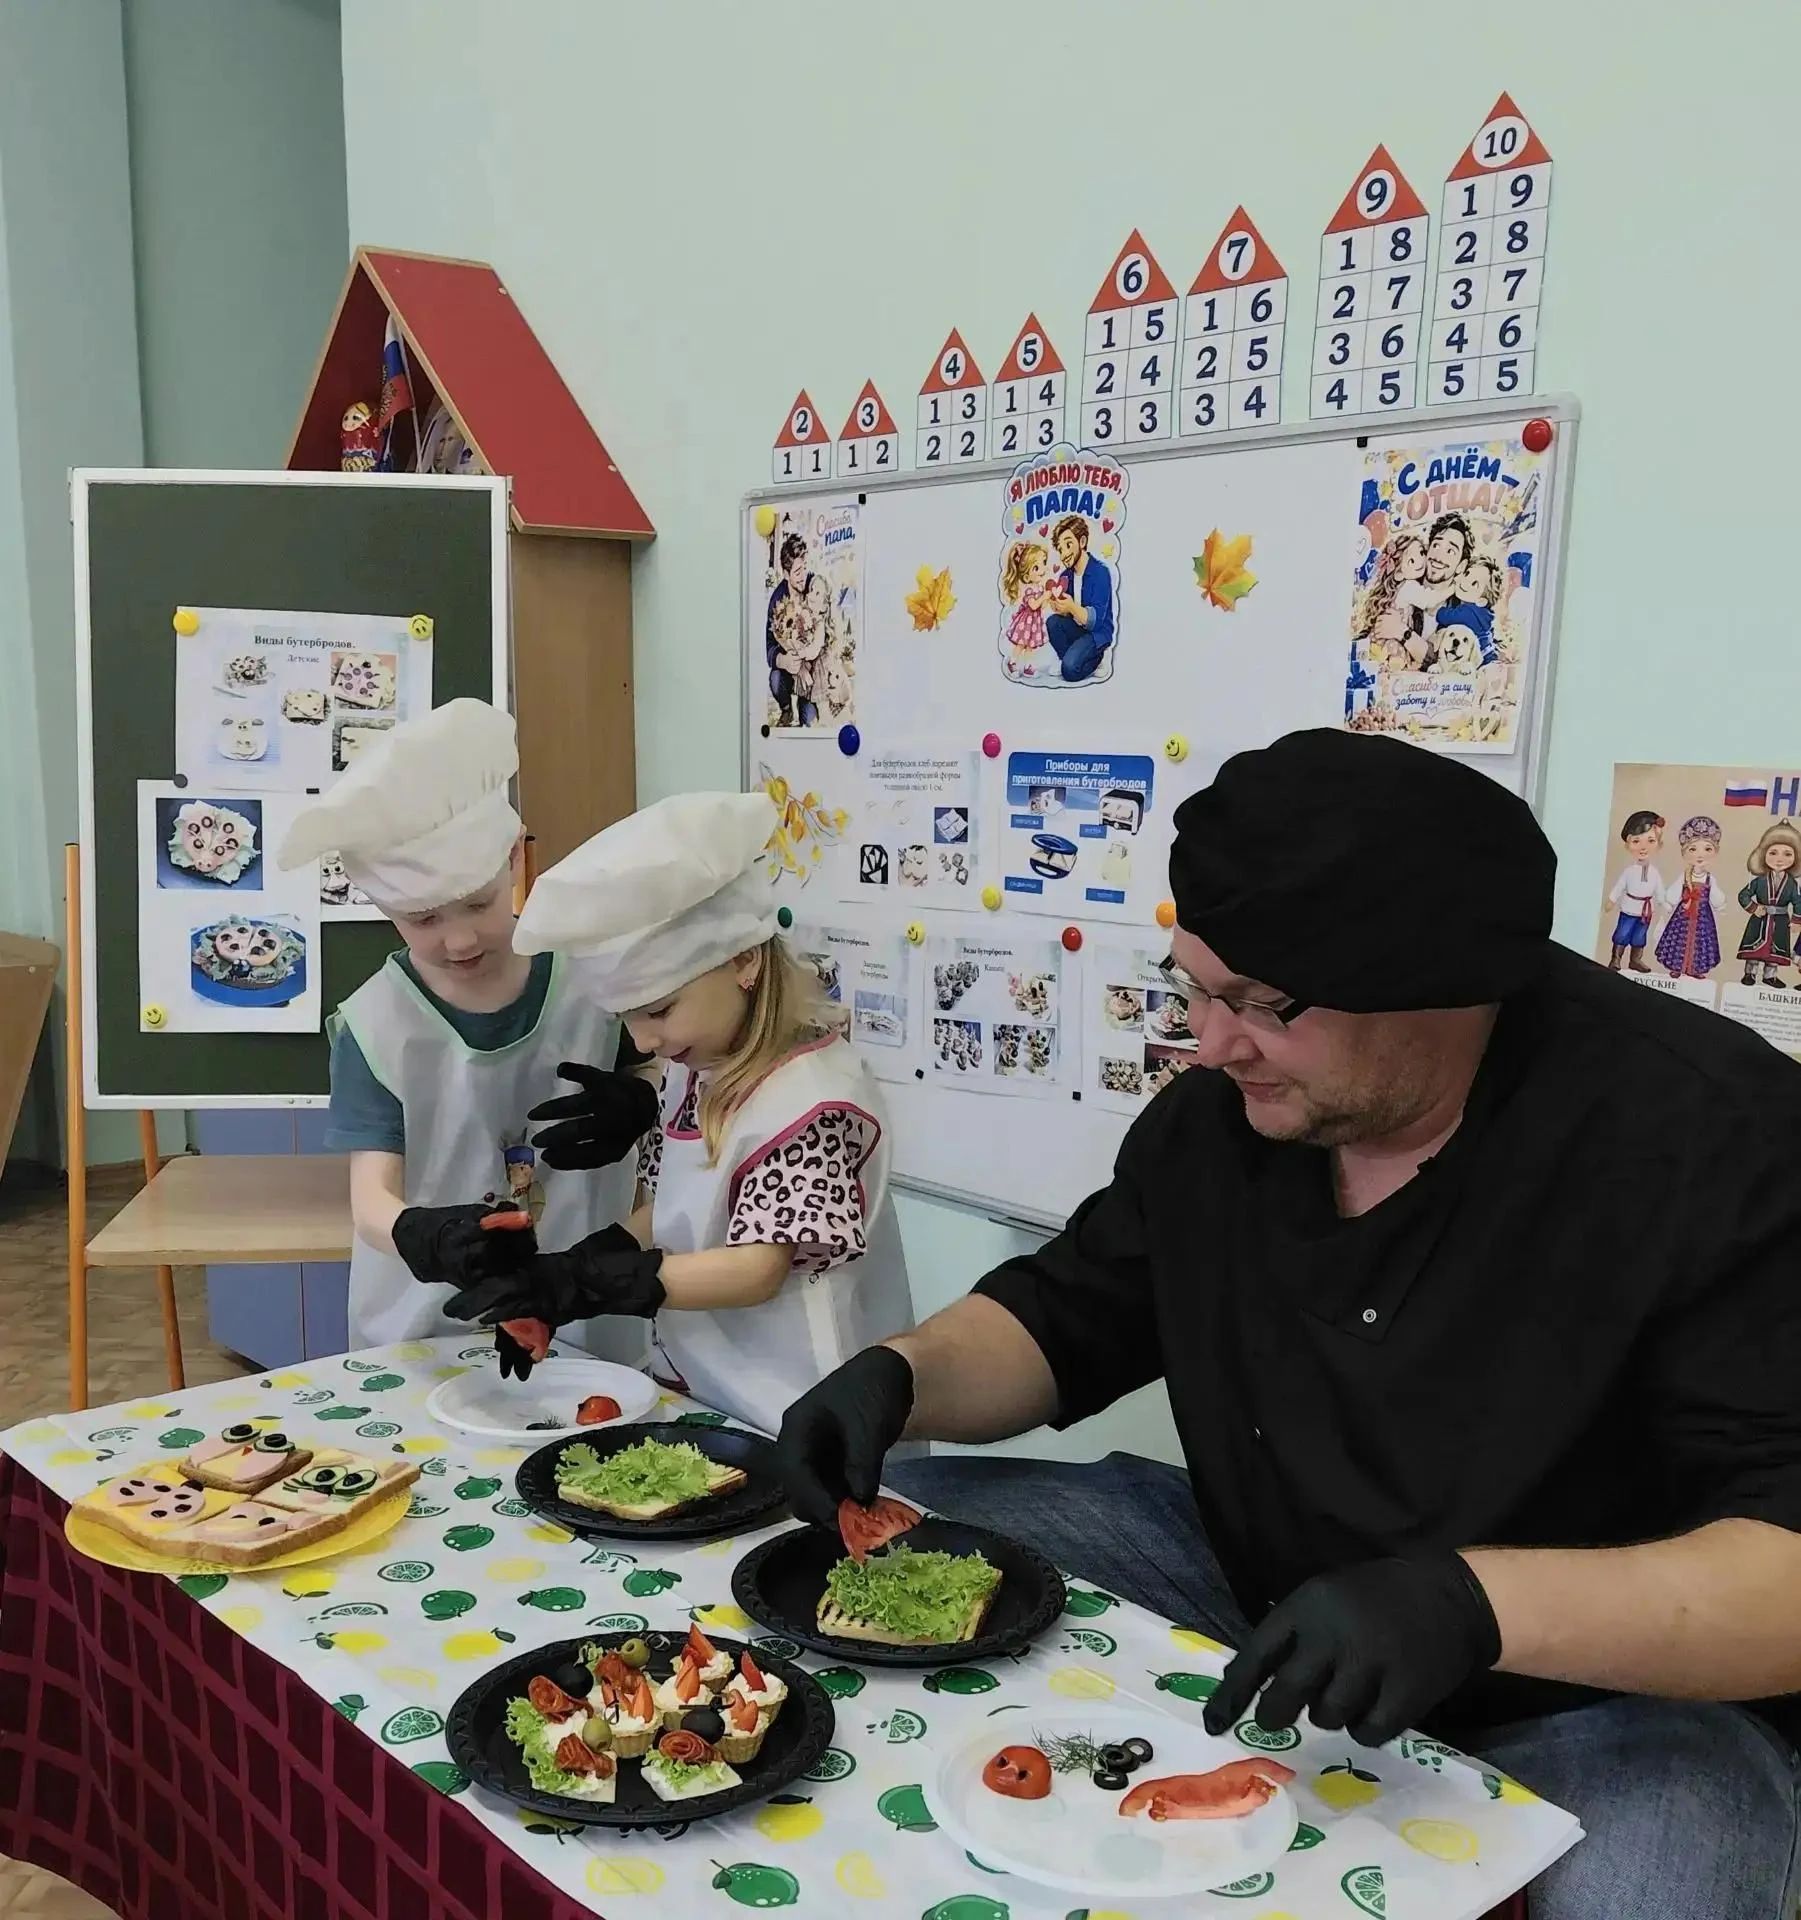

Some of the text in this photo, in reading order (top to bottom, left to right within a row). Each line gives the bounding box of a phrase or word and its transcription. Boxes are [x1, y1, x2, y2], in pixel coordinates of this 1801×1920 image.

[1483, 127, 1518, 159] 10
[1365, 178, 1388, 213] 9
[1461, 174, 1534, 218] 1 9
[1226, 238, 1249, 273] 7
[1339, 227, 1412, 271] 1 8
[1454, 221, 1529, 265] 2 8
[1123, 260, 1143, 294] 6
[1450, 269, 1528, 311] 3 7
[1202, 288, 1273, 332] 1 6
[1332, 276, 1411, 319] 2 7
[1101, 307, 1165, 349] 1 5
[1328, 324, 1404, 366] 3 6
[1445, 315, 1522, 354] 4 6
[945, 354, 961, 380] 4
[1022, 338, 1038, 367] 5
[1196, 336, 1268, 380] 2 5
[1095, 355, 1161, 395] 2 4
[1325, 370, 1401, 411] 4 5
[1443, 359, 1519, 397] 5 5
[930, 393, 977, 424] 1 3
[1005, 380, 1056, 413] 1 4
[1194, 386, 1267, 427] 3 4
[796, 410, 809, 434] 2
[861, 403, 875, 428] 3
[1094, 402, 1158, 440] 3 3
[926, 431, 975, 461] 2 2
[1002, 419, 1054, 452] 2 3
[783, 449, 822, 475] 1 1
[848, 440, 889, 468] 1 2
[1398, 447, 1502, 495] С ДНЁМ
[1010, 463, 1122, 503] Я ЛЮБЛЮ ТЕБЯ,
[1026, 488, 1105, 524] ПАПА!
[1406, 481, 1505, 521] ОТЦА!
[825, 526, 856, 547] папа,
[254, 635, 356, 649] Виды бутербродов.
[287, 654, 320, 664] Детские
[1395, 694, 1428, 710] заботу
[1429, 696, 1437, 704] и
[1440, 683, 1450, 695] за
[1452, 683, 1474, 695] силу,
[1012, 774, 1147, 790] приготовления бутербродов
[1045, 759, 1110, 774] Приборы для
[1771, 776, 1801, 817] Н
[1147, 959, 1160, 967] Вид
[1633, 976, 1678, 990] РУССКИЕ
